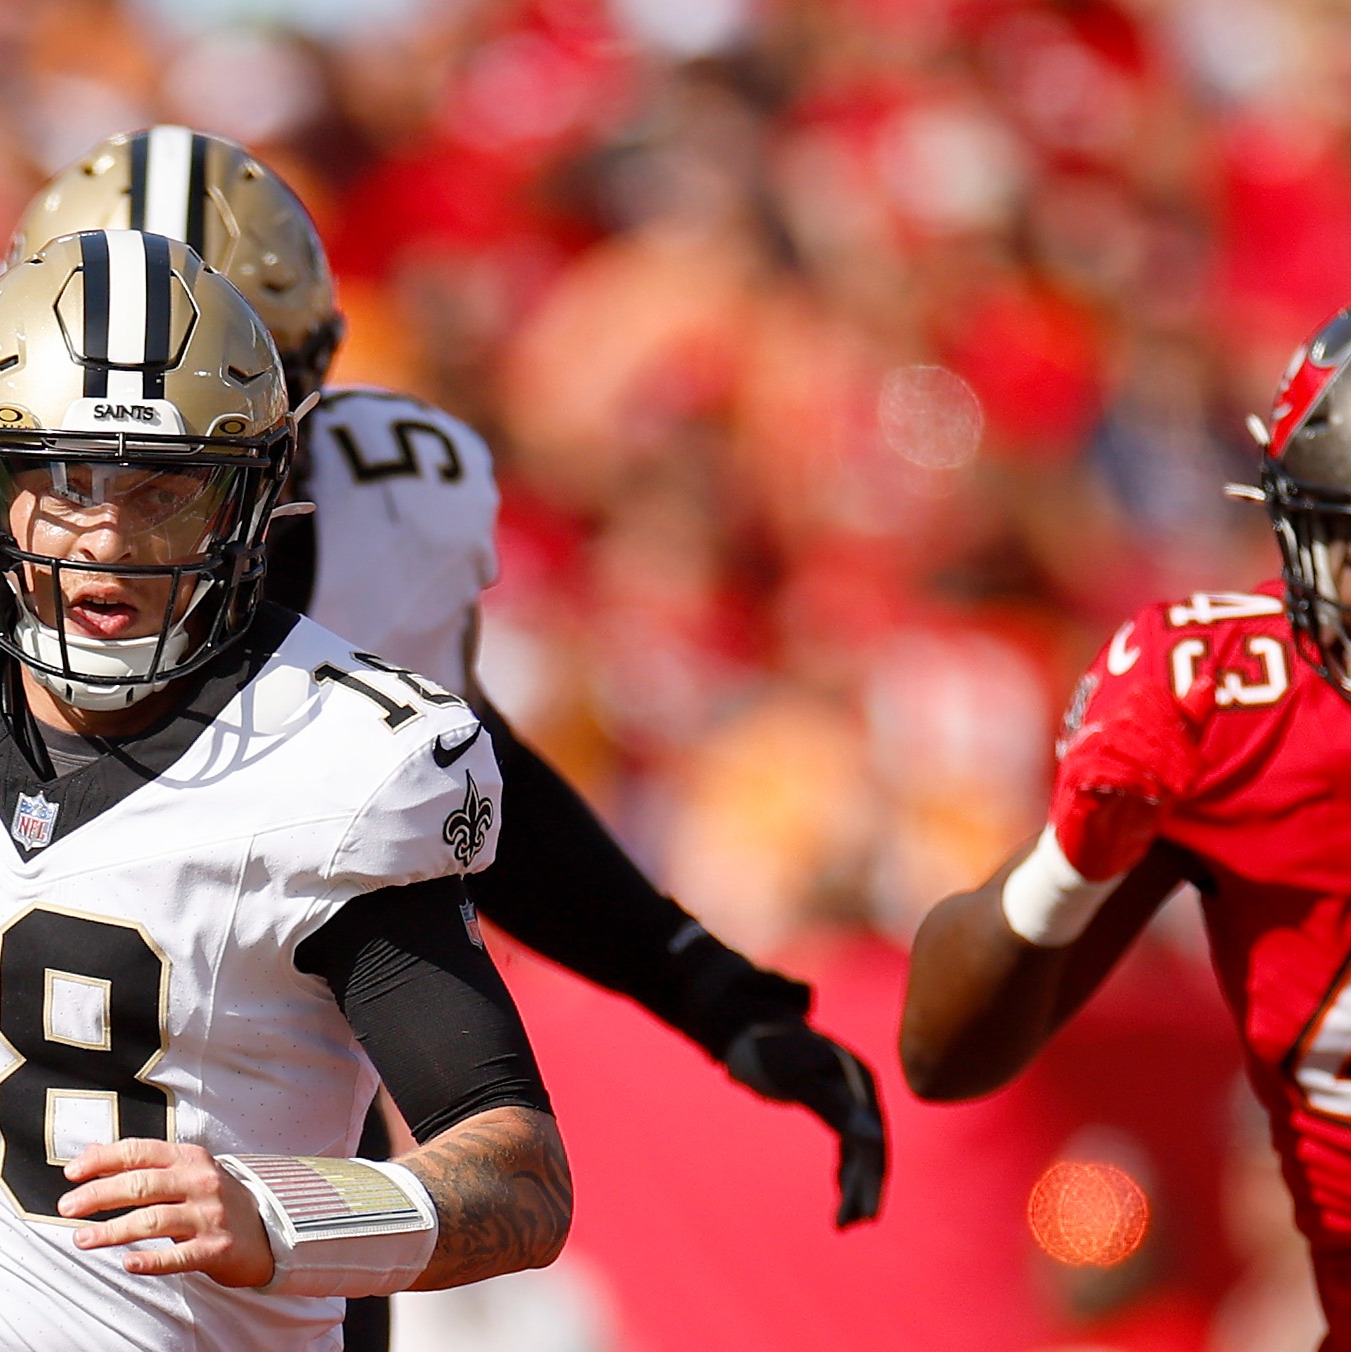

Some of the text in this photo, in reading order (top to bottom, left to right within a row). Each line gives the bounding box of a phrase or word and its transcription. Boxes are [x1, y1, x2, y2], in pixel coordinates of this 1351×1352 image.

[93, 403, 155, 421] SAINTS
[1164, 590, 1292, 708] 43
[18, 815, 48, 840] NFL
